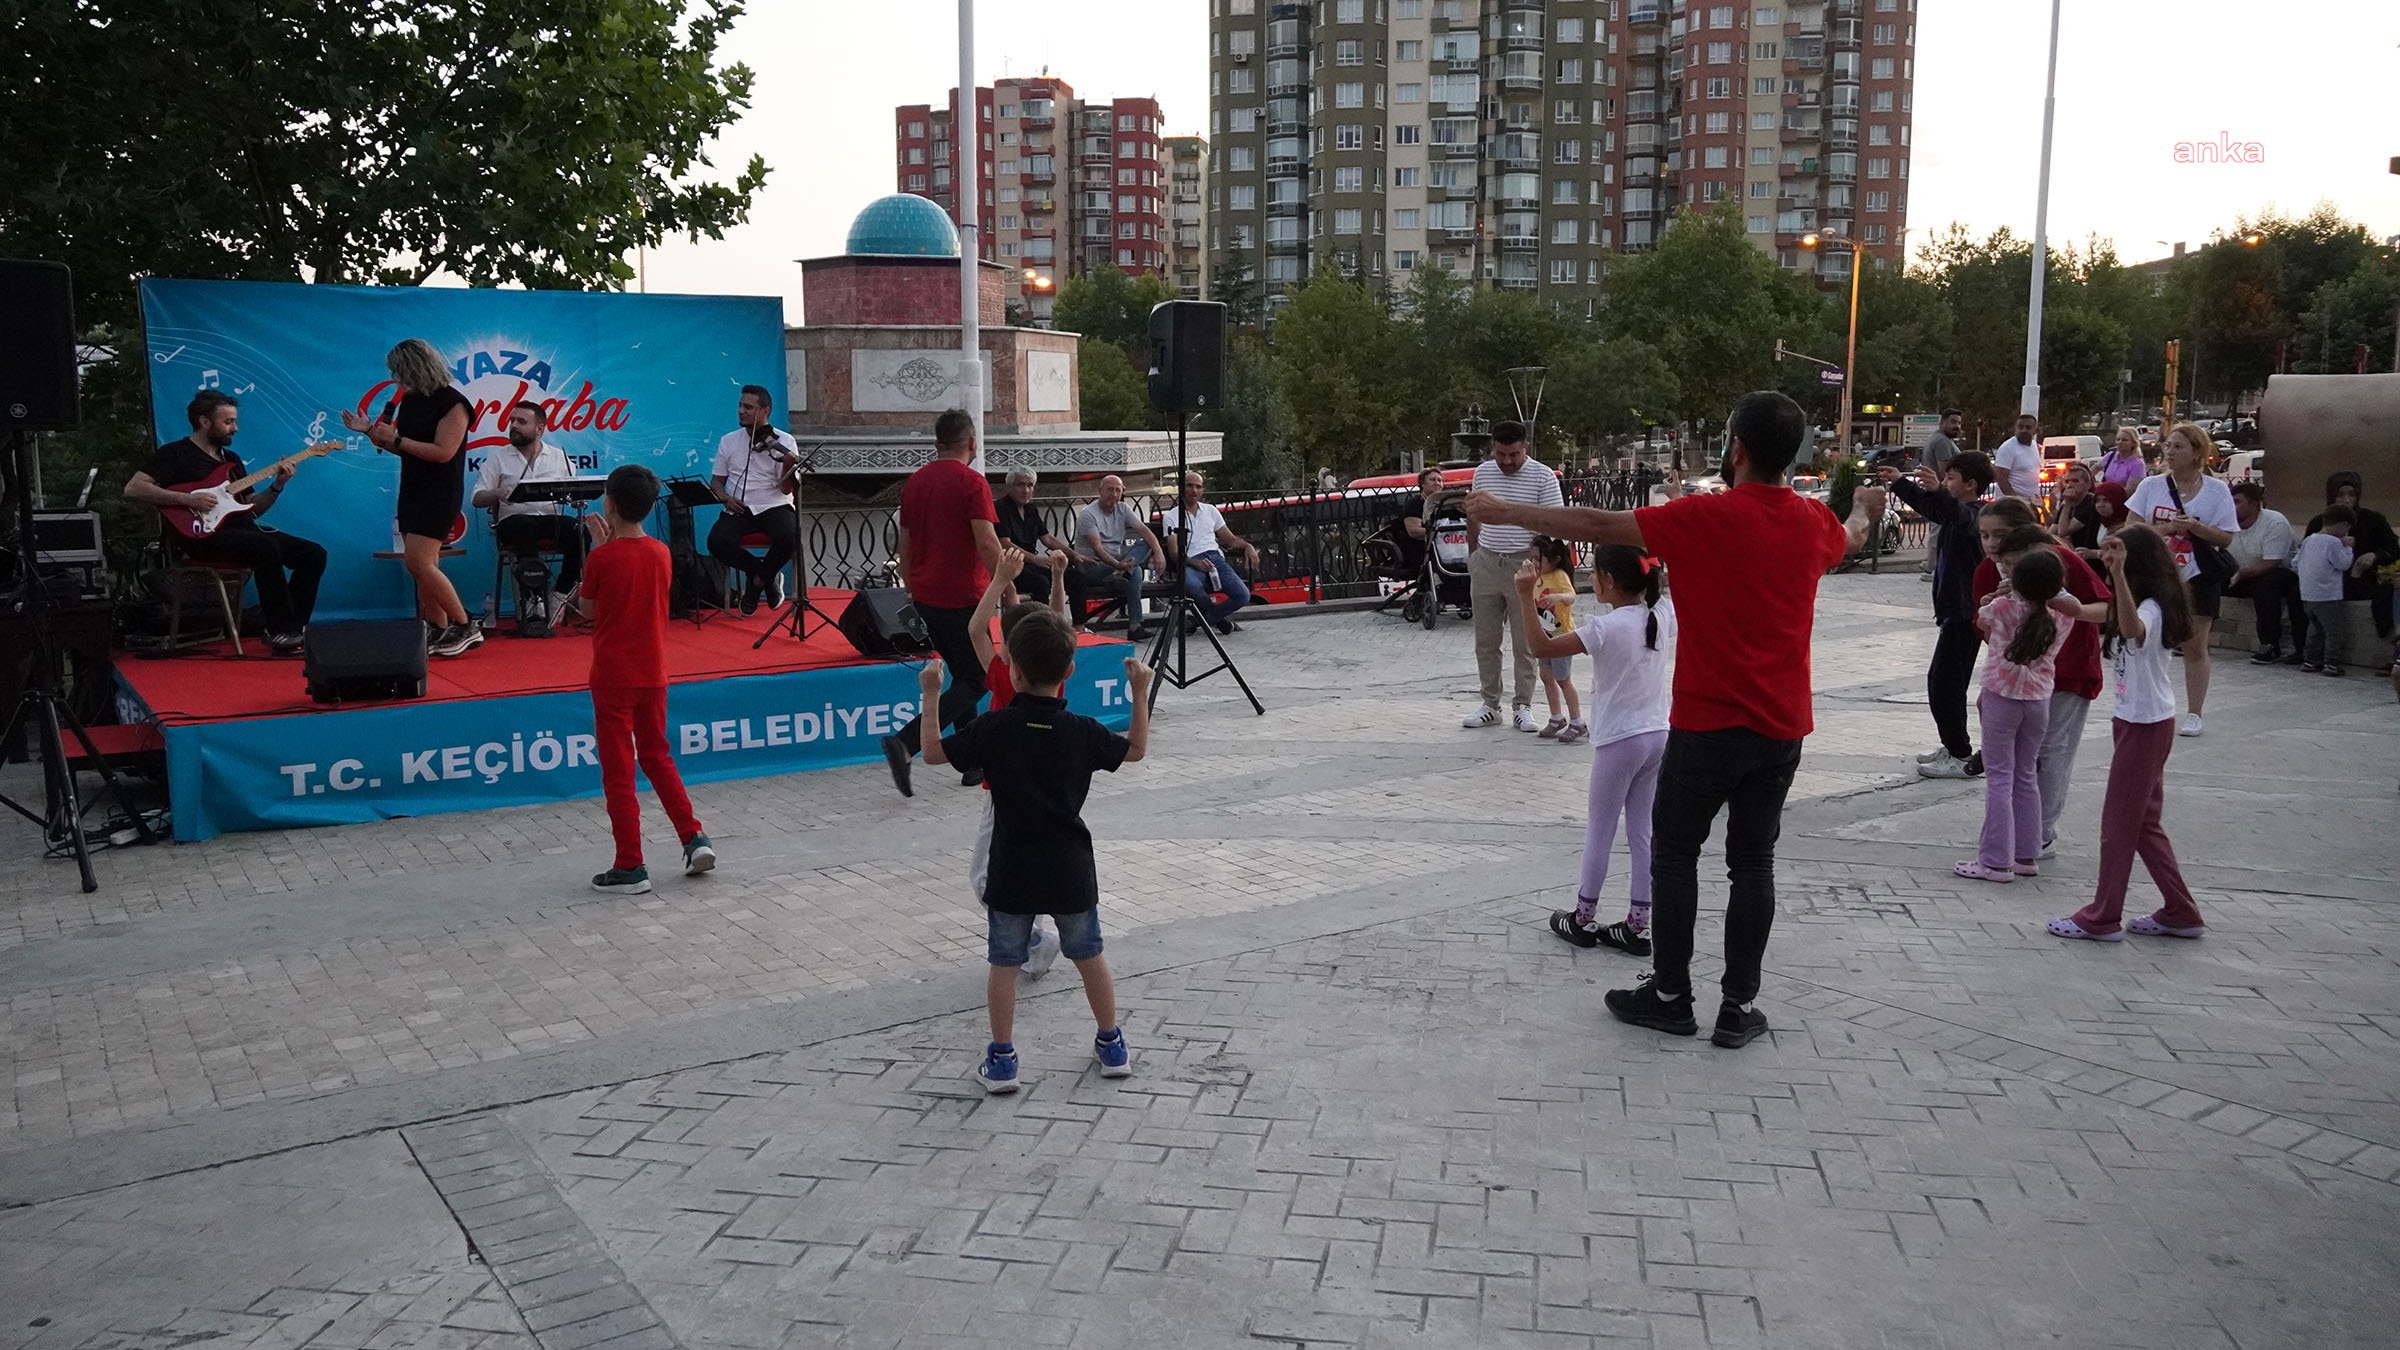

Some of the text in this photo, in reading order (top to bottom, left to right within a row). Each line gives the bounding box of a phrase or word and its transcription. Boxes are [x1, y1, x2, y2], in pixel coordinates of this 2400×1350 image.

[450, 350, 552, 391] YAZA
[357, 380, 631, 442] rhaba
[280, 692, 924, 796] T.C. KEÇİÖR BELEDİYES
